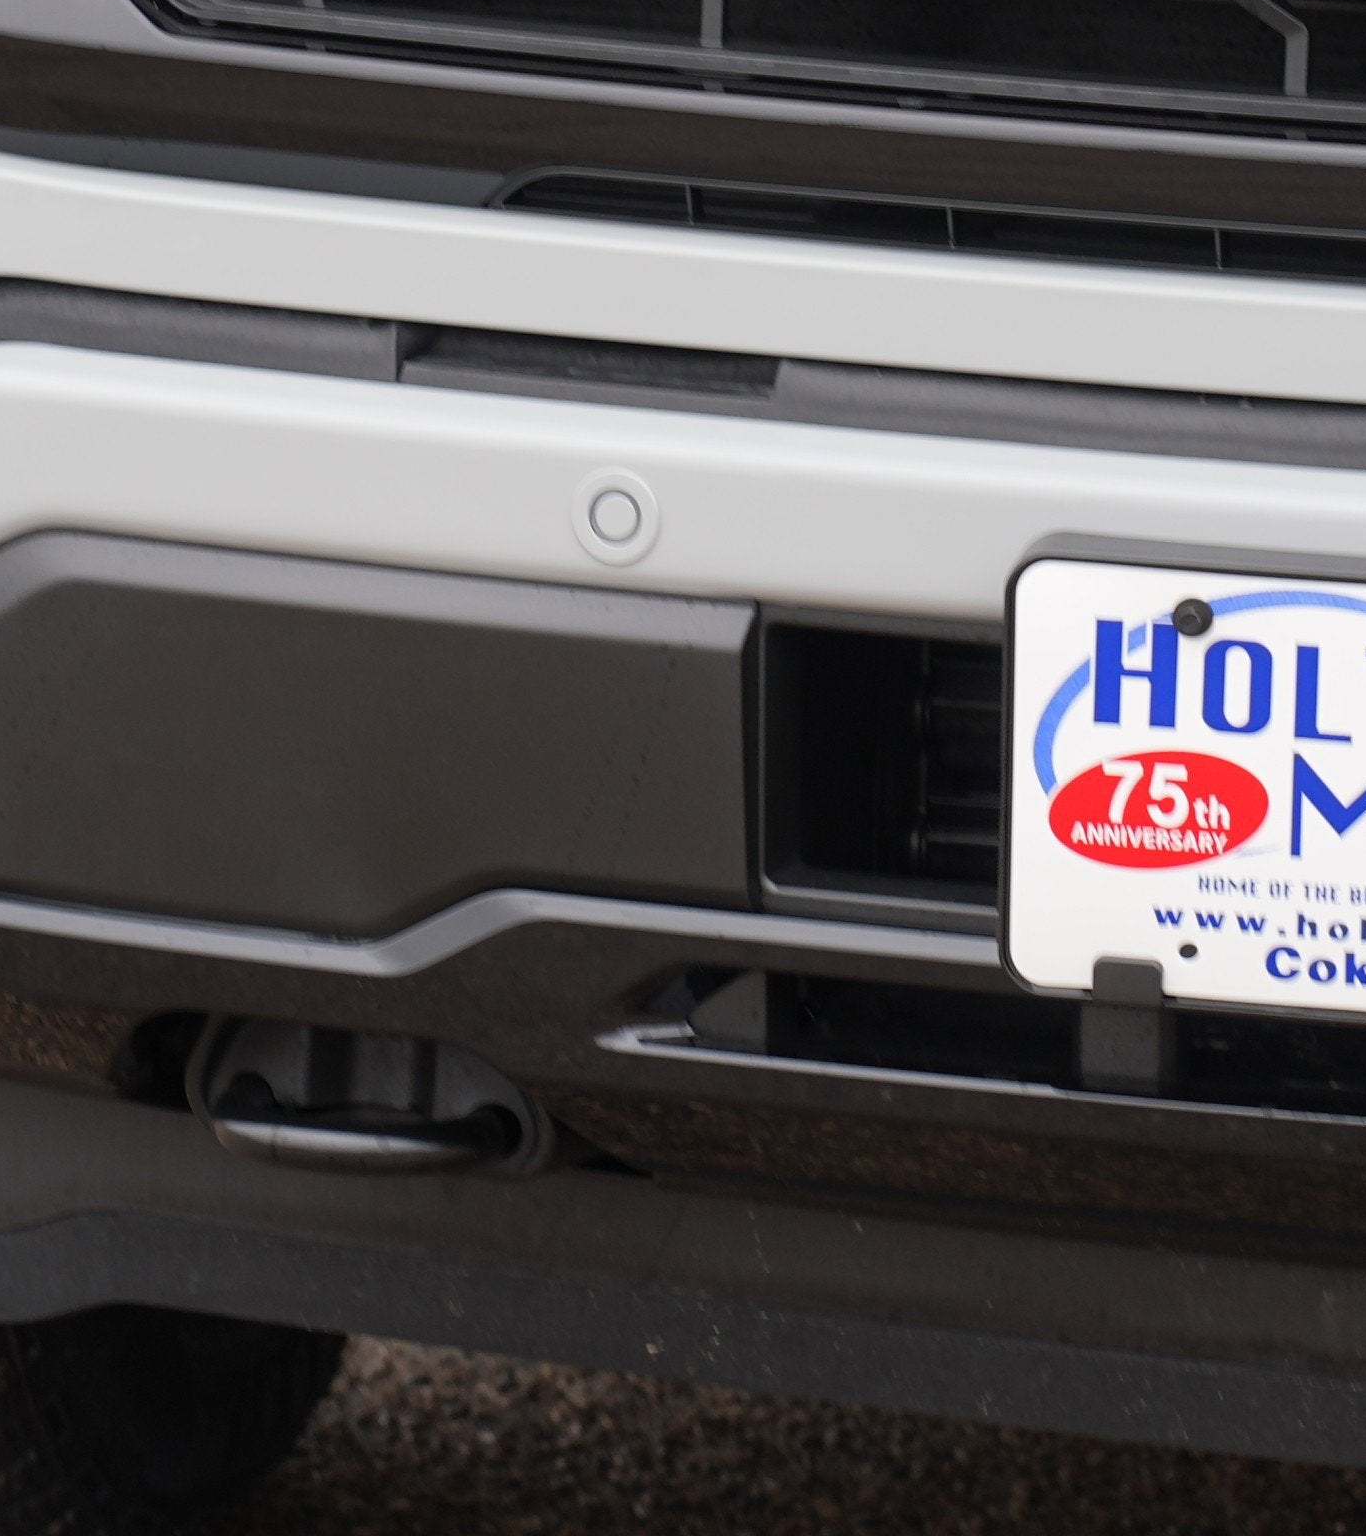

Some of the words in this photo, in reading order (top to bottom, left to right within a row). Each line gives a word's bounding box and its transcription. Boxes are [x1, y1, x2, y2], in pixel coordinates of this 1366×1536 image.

[1101, 760, 1232, 830] 75th
[1070, 820, 1230, 856] ANNIVERSARY
[1198, 874, 1259, 899] HOME
[1269, 880, 1291, 900] OF
[1303, 882, 1338, 903] THE
